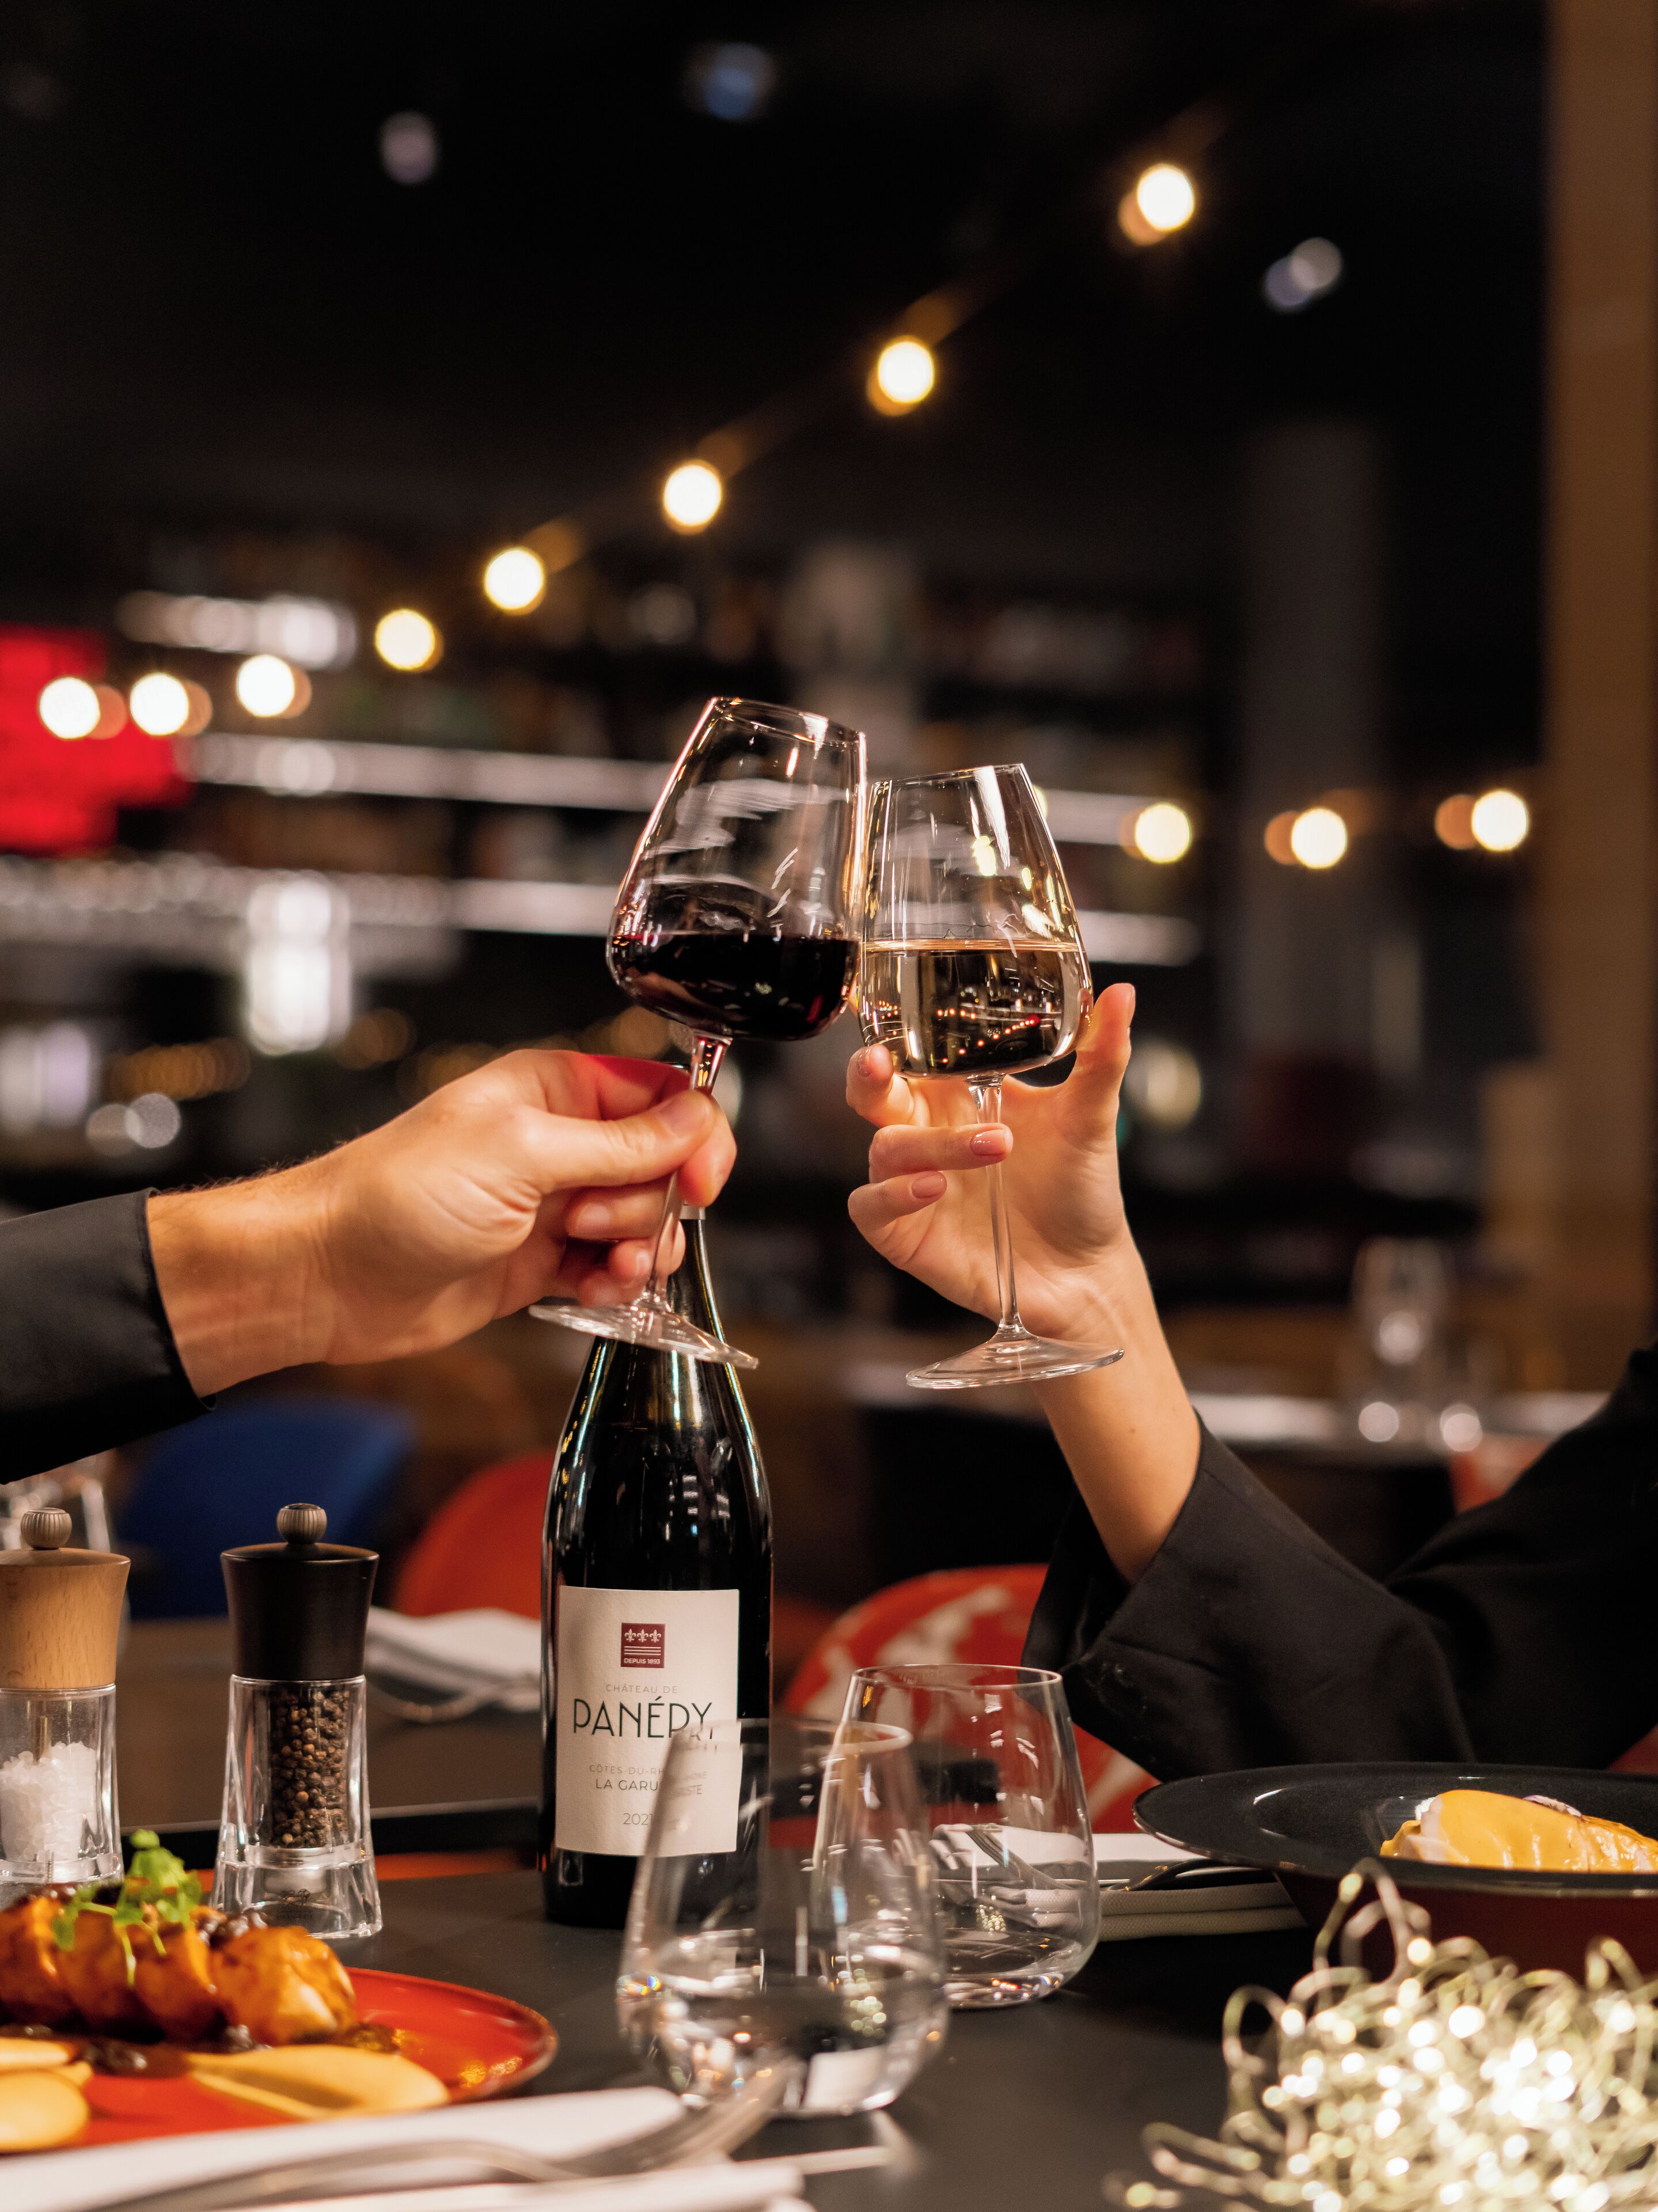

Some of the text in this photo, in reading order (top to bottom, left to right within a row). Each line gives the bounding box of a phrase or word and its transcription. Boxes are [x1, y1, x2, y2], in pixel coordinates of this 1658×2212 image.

[606, 1683, 678, 1694] CHÂTEAU DE
[595, 1778, 613, 1790] LA
